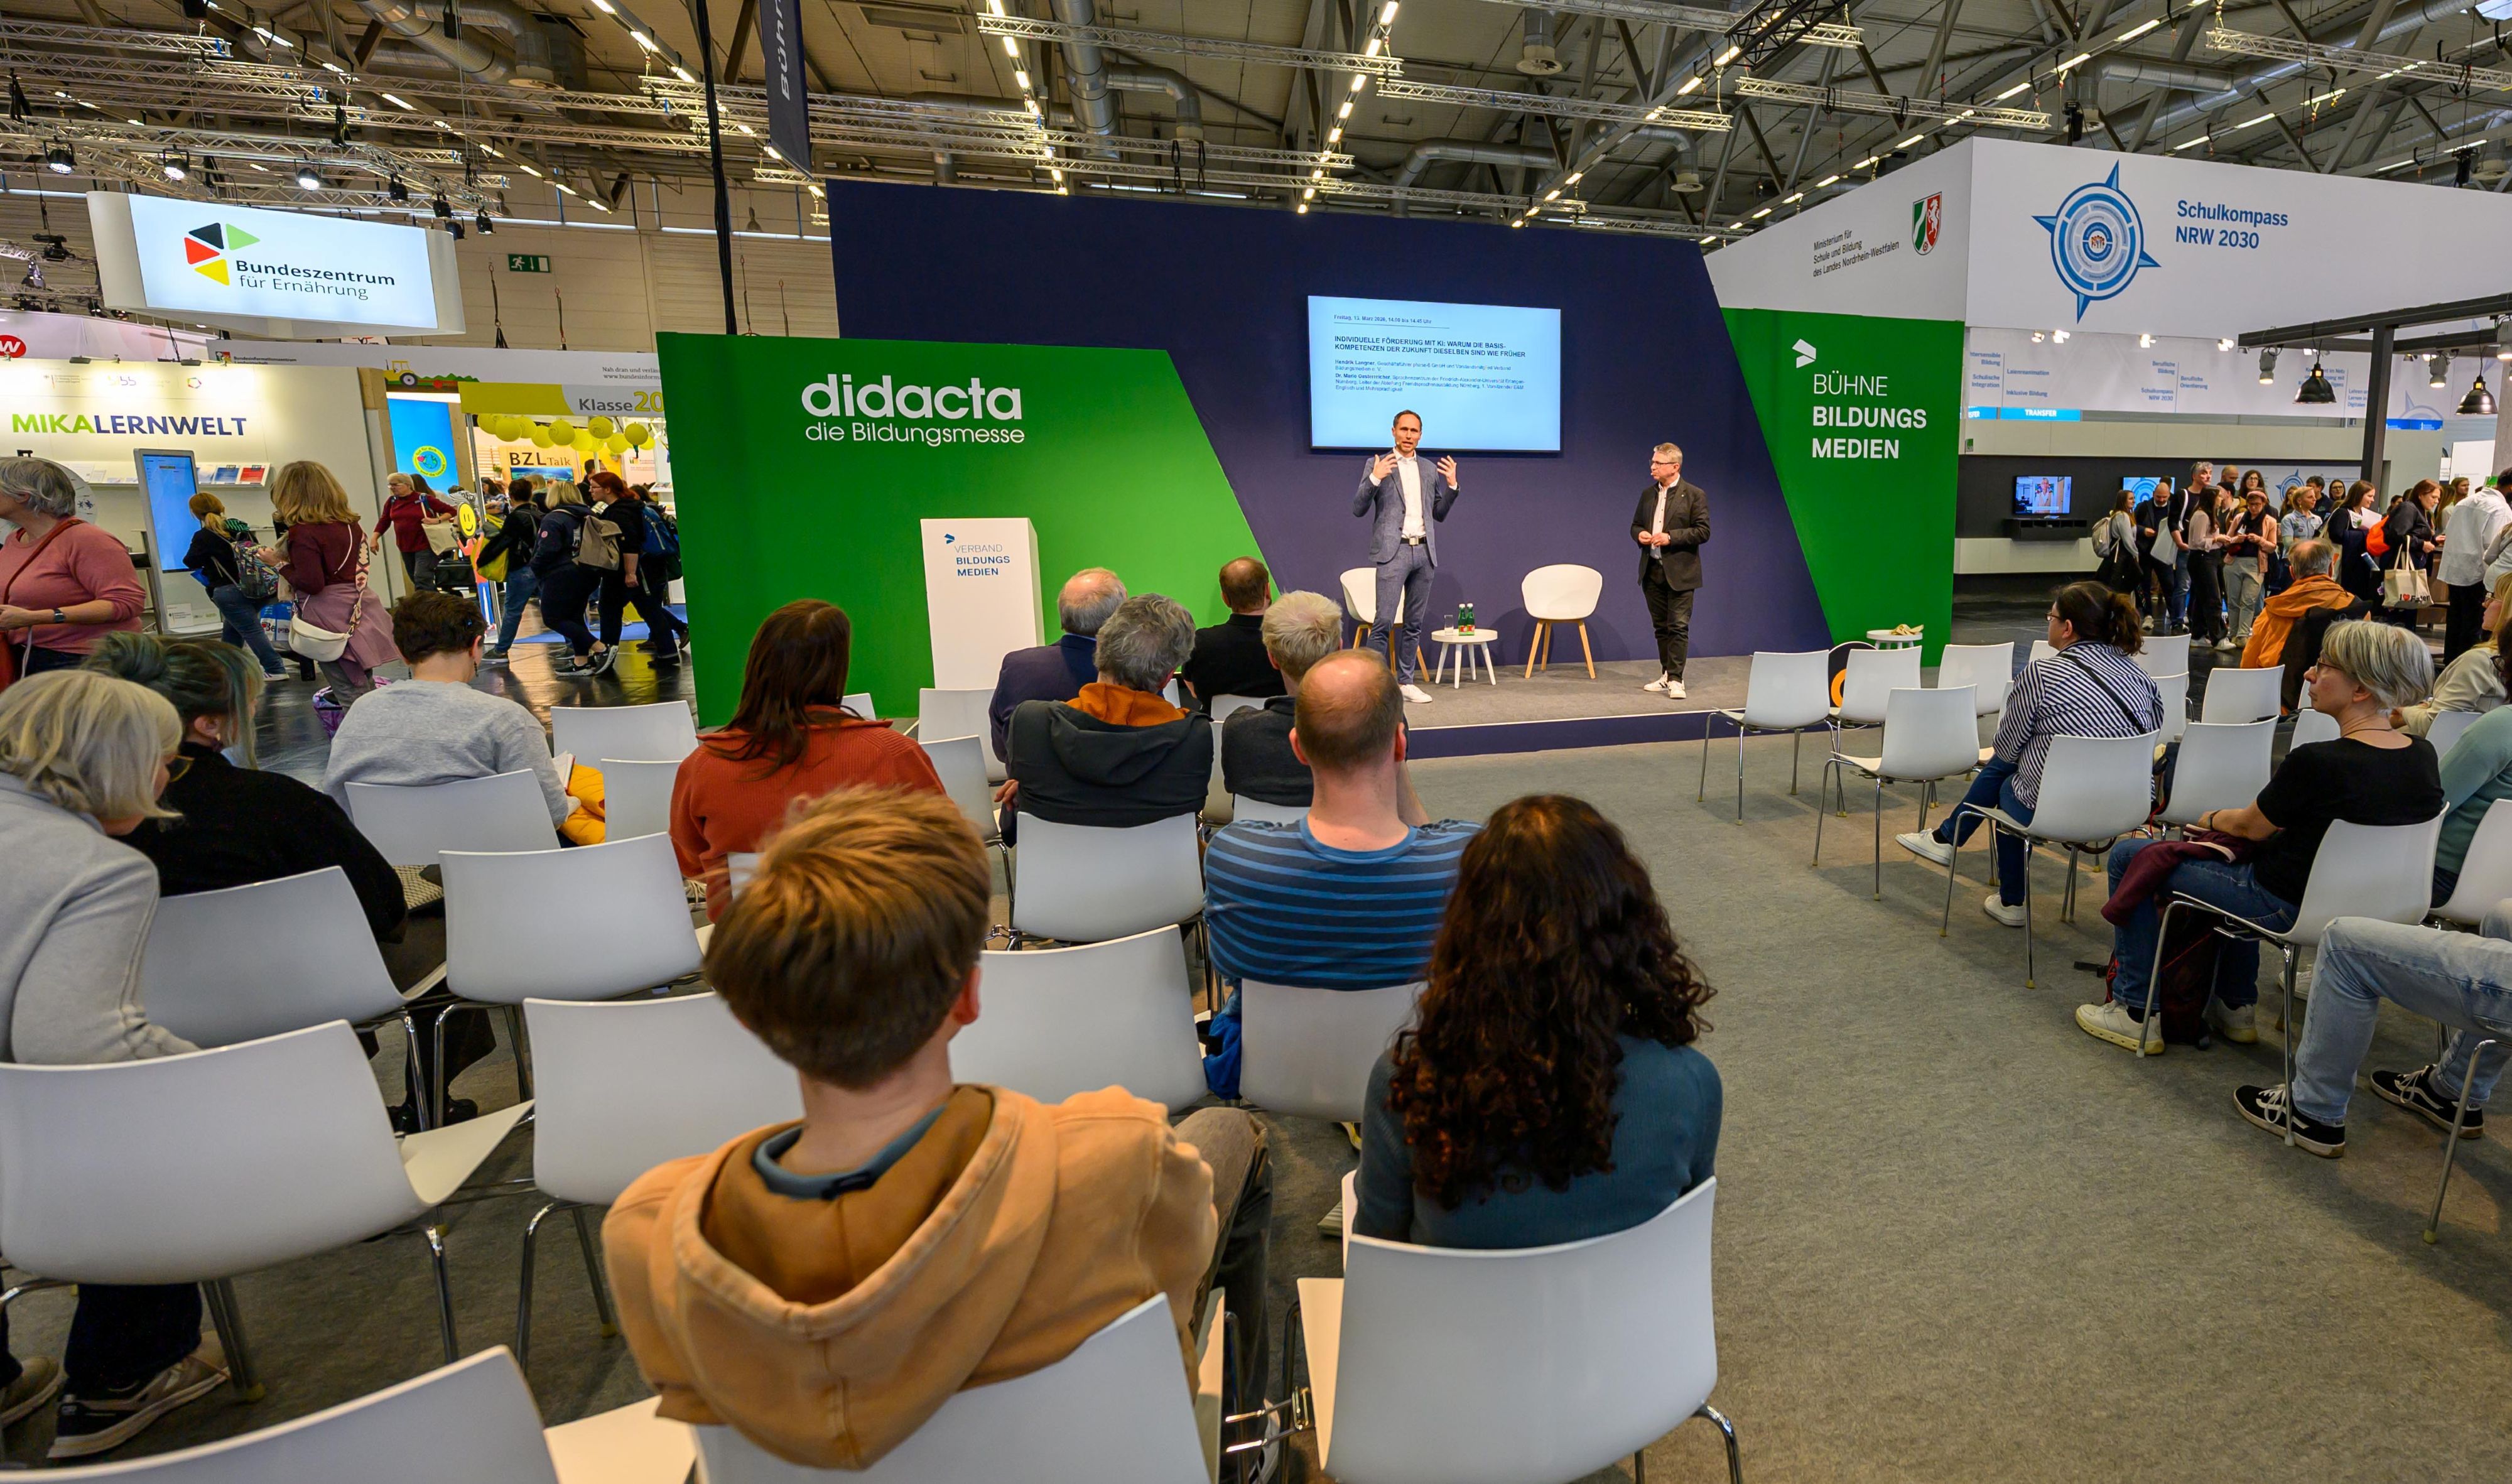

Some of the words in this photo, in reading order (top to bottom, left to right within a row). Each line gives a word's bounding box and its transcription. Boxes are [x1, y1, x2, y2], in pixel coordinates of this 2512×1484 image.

[2177, 199, 2288, 227] Schulkompass
[1814, 233, 1843, 251] Ministerium
[1844, 230, 1852, 239] für
[2175, 225, 2214, 246] NRW
[2218, 229, 2260, 249] 2030
[1813, 268, 1822, 277] des
[1823, 261, 1841, 274] Landes
[1842, 241, 1899, 268] Nordrhein-Westfalen
[1814, 251, 1830, 264] Schule
[1831, 247, 1841, 257] und
[1842, 240, 1862, 254] Bildung
[236, 260, 395, 286] Bundeszentrum
[239, 274, 266, 288] für
[273, 278, 368, 301] Ernährung
[1334, 344, 1385, 352] KOMPETENZEN
[1382, 337, 1423, 345] FÖRDERUNG
[1814, 370, 1888, 396] BÜHNE
[801, 373, 1022, 420] didacta
[12, 413, 247, 436] MIKALERNWELT
[1813, 406, 1927, 429] BILDUNGS
[2025, 409, 2057, 418] TRANSFER
[805, 421, 845, 441] die
[852, 422, 1025, 447] Bildungsmesse
[509, 452, 546, 466] BZL
[546, 457, 571, 466] Talk
[1812, 438, 1899, 459] MEDIEN
[955, 544, 1003, 553] VERBAND
[956, 555, 1010, 565] BILDUNGS
[957, 568, 999, 577] MEDIEN
